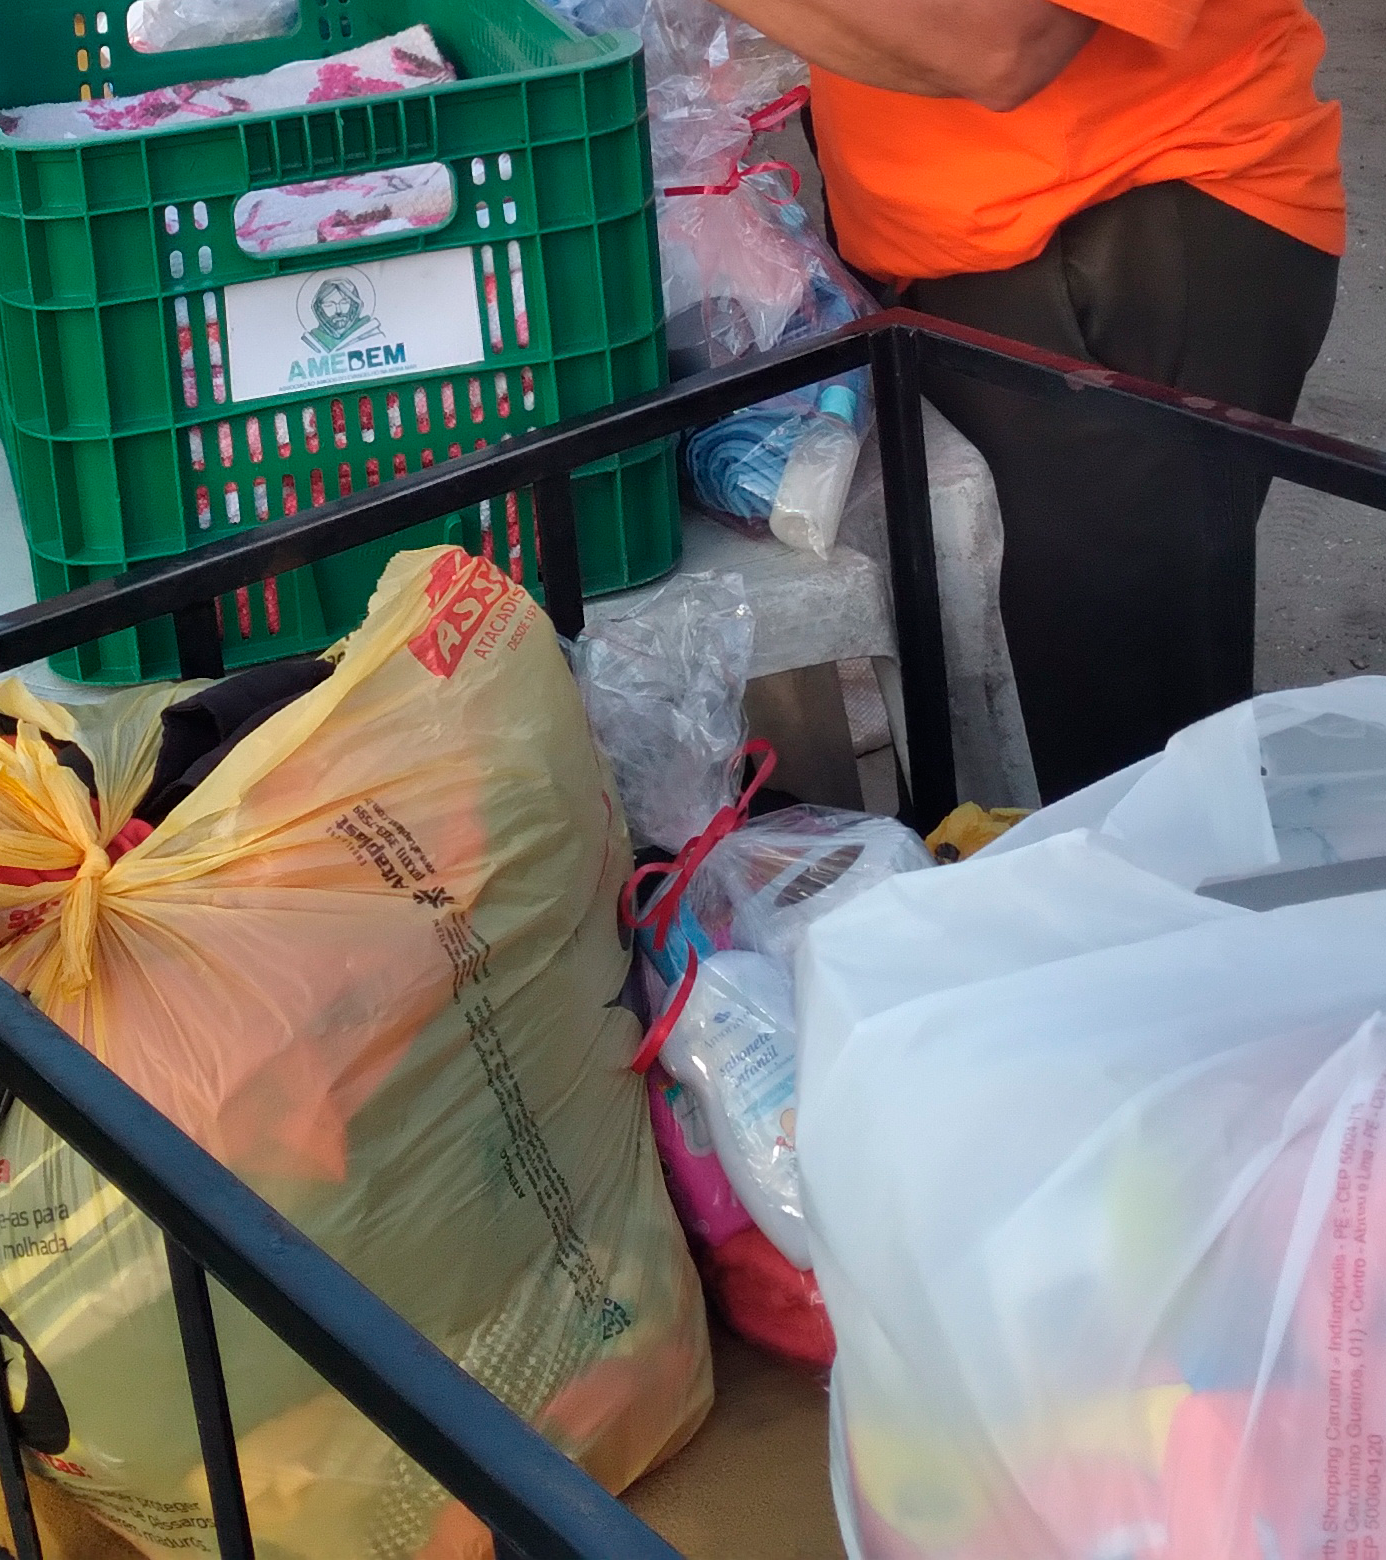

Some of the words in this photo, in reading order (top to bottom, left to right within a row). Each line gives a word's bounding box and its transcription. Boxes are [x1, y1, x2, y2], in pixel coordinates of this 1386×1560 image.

[288, 342, 407, 383] AMEBEM
[506, 621, 530, 652] DESDE
[335, 813, 410, 889] Altaplast
[1336, 1169, 1351, 1203] CEP
[1333, 1218, 1349, 1240] PE
[1350, 1258, 1367, 1312] Centro
[1323, 1446, 1344, 1533] Shopping
[1364, 1535, 1379, 1560] EP
